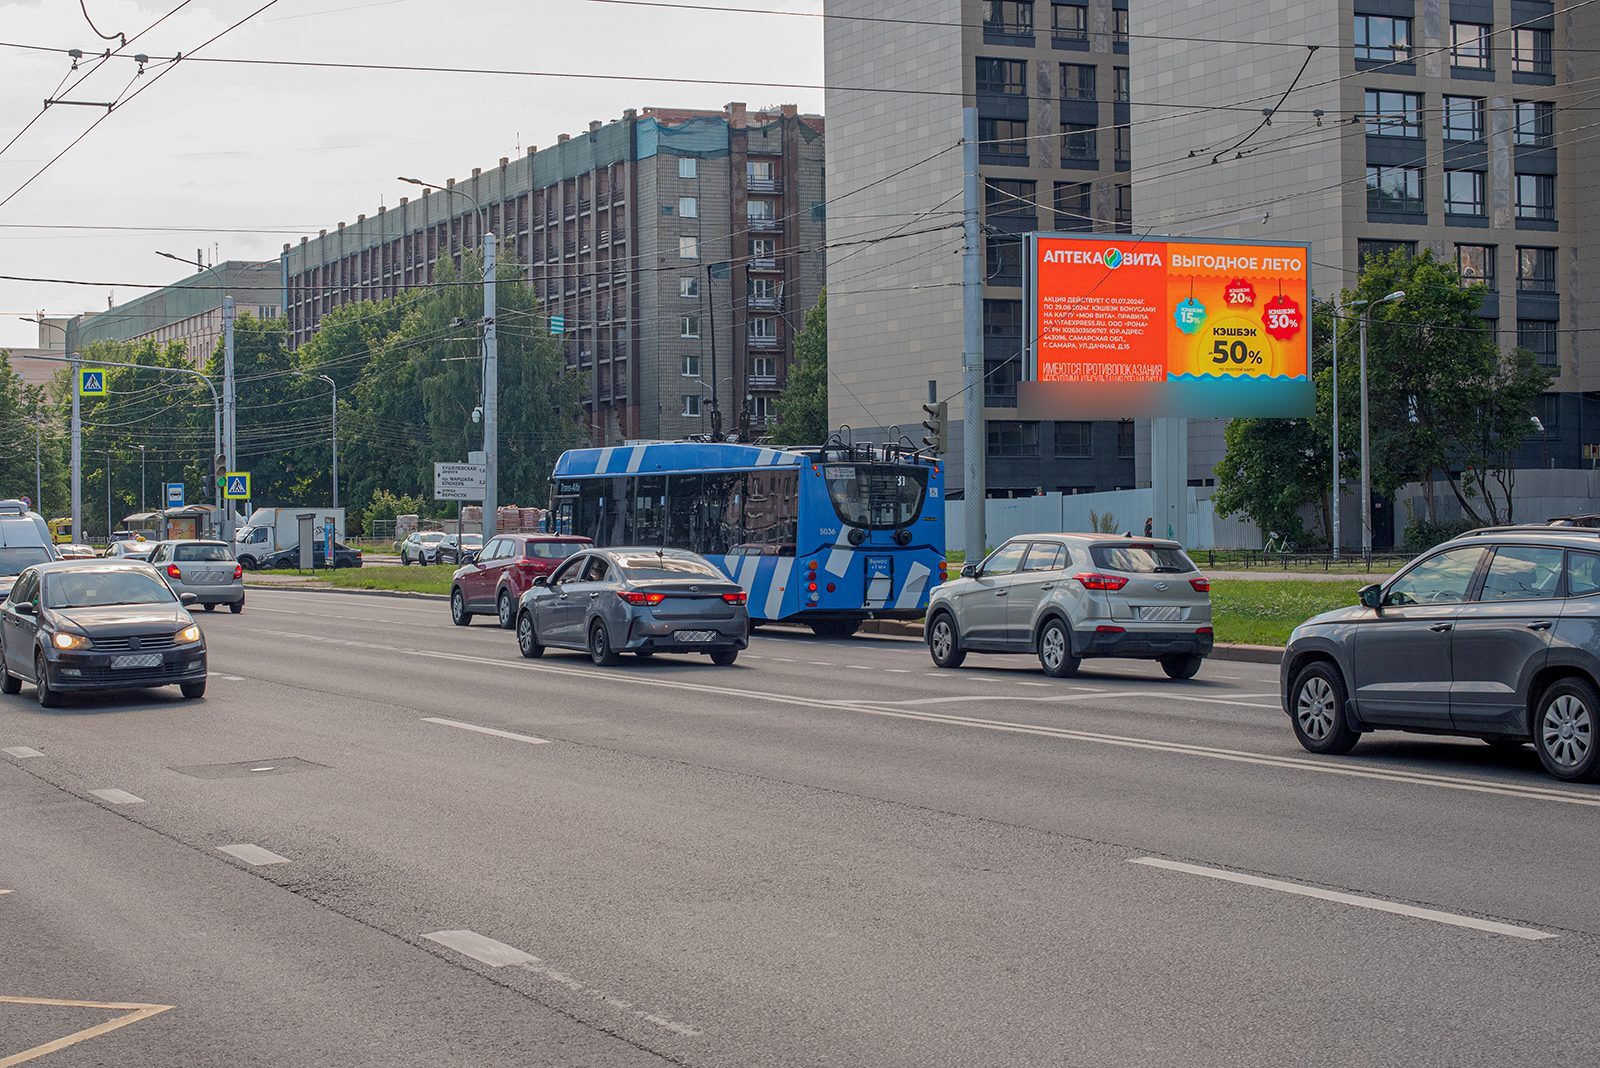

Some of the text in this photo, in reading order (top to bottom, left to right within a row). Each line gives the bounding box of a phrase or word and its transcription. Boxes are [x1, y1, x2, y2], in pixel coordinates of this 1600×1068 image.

[1044, 250, 1162, 267] АПТЕКА ВИТА
[1172, 254, 1302, 272] ВЫГОДНОЕ ЛЕТО
[1213, 327, 1257, 337] КЭШБЭК
[1043, 362, 1162, 376] ИМЕЮТСЯ ПРОТИВОПОКАЗАНИЯ
[896, 476, 905, 486] 31
